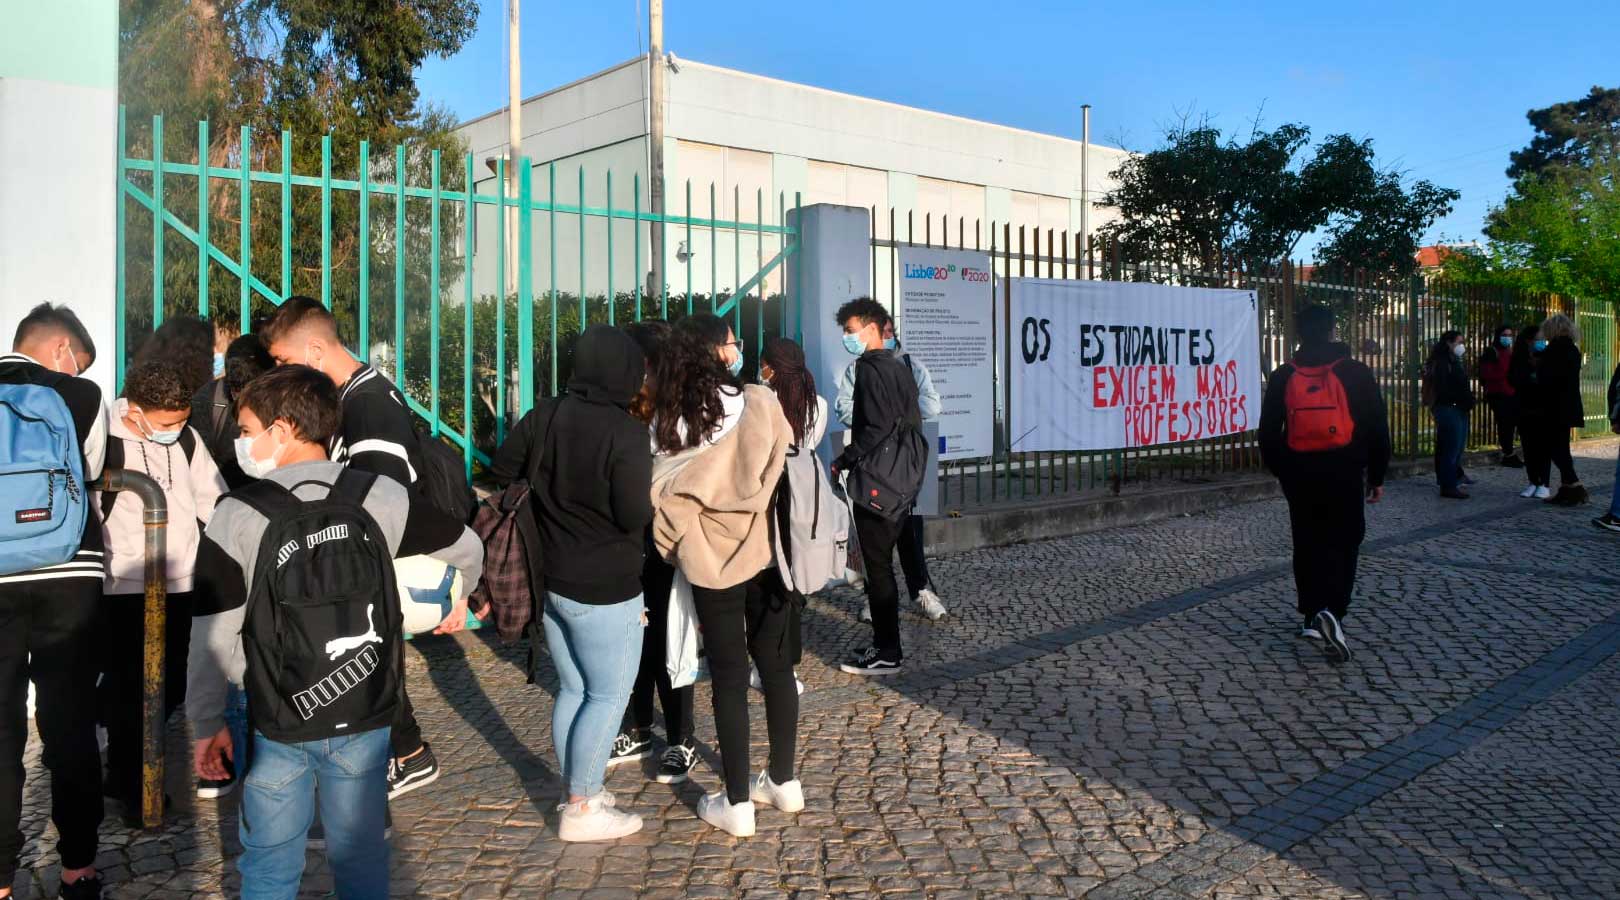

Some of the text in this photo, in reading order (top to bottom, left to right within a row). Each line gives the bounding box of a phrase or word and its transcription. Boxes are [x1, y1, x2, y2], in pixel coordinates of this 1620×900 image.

[1021, 316, 1215, 367] OS ESTUDANTES
[1093, 359, 1238, 408] EXIGEM MAIS
[1124, 394, 1248, 449] PROFESSORES
[306, 523, 349, 549] PUMA
[292, 644, 379, 721] PUMA
